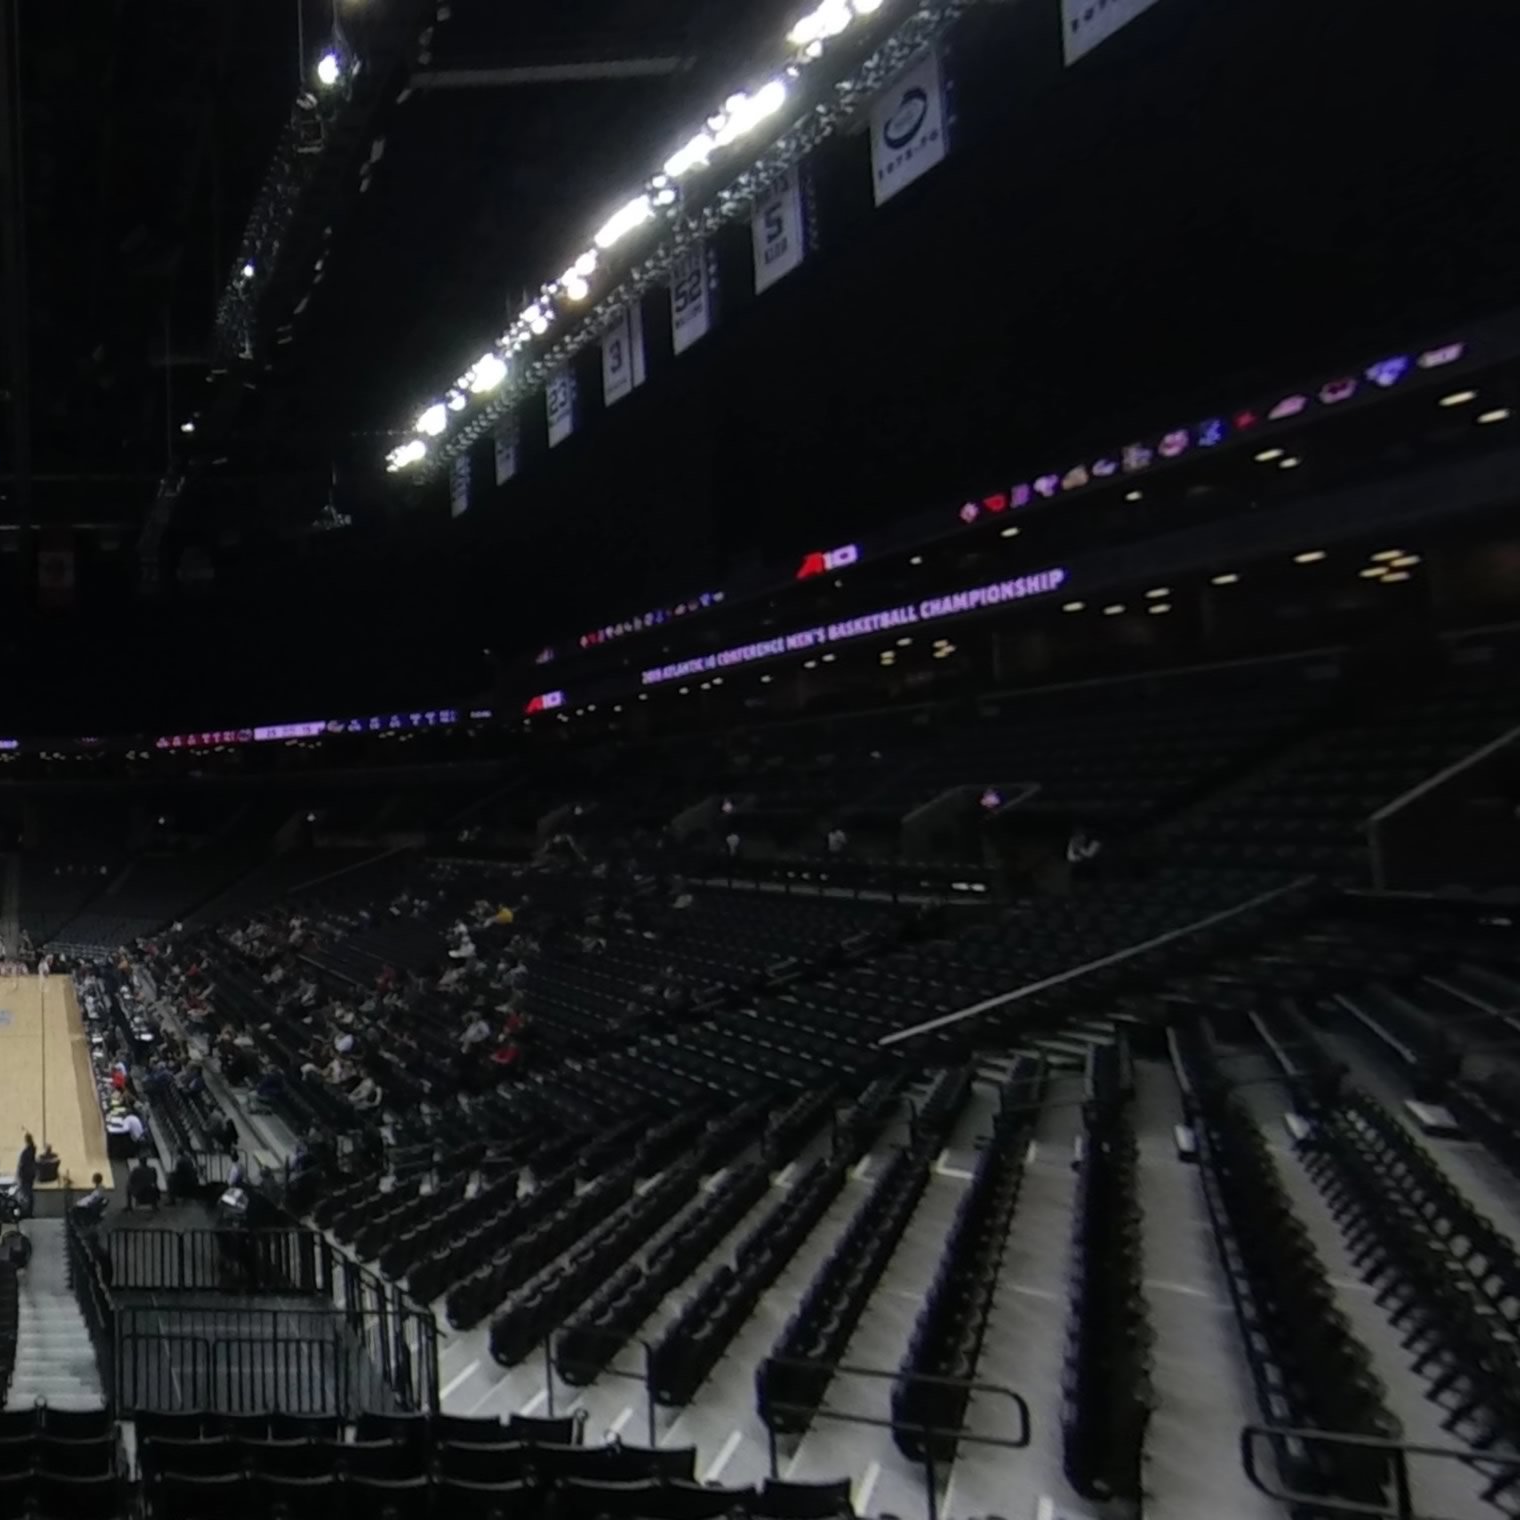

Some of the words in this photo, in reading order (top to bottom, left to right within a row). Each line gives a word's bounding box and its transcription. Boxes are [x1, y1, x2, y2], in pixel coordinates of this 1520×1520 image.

[765, 206, 783, 243] 5
[675, 268, 702, 313] 52
[717, 637, 784, 666] CONFERENCE
[786, 627, 826, 650] MEN'S
[828, 607, 918, 640] BASKETBALL
[920, 567, 1065, 619] CHAMPIONSHIP
